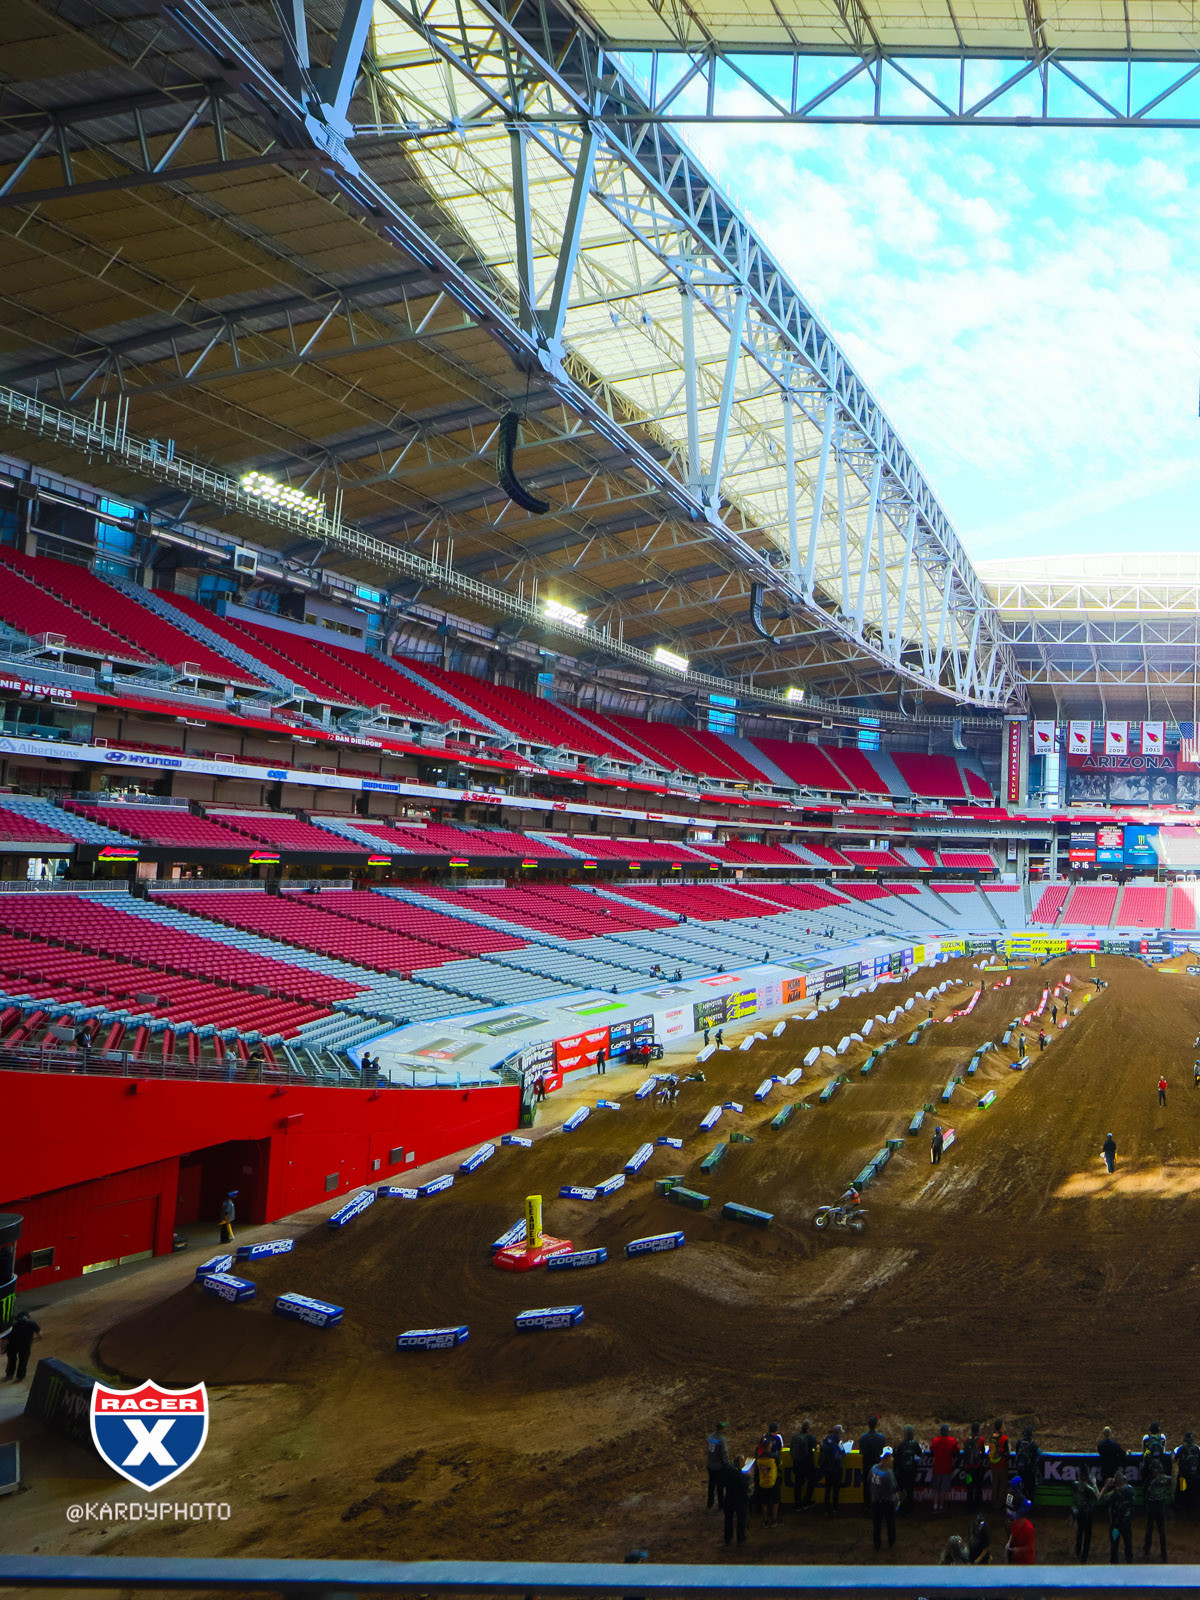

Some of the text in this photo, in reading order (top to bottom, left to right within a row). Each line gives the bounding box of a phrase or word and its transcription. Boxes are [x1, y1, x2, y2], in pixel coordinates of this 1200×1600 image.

[25, 683, 73, 698] NEVERS
[335, 735, 350, 743] DAN
[351, 737, 383, 748] DIERDORF
[17, 742, 79, 759] Albertsons
[129, 754, 182, 767] HYUNDAI
[1082, 755, 1175, 769] ARIZONA
[201, 763, 248, 775] HYUNDAI
[267, 769, 288, 780] COX
[324, 776, 342, 785] COX
[611, 1023, 631, 1033] GoPro
[634, 1018, 652, 1026] GoPro
[611, 1040, 631, 1050] GoPro
[389, 1186, 419, 1195] COOPER
[427, 1176, 454, 1193] COOPER
[570, 1188, 598, 1196] COOPER
[341, 1193, 375, 1224] COOPER
[251, 1239, 293, 1254] COOPER
[272, 1246, 292, 1255] TIRES
[628, 1238, 675, 1252] COOPER
[651, 1244, 675, 1252] TIRES
[542, 1247, 572, 1260] HONDA
[549, 1253, 598, 1266] COOPER
[203, 1278, 238, 1296] COOPER
[219, 1288, 236, 1302] TIRES
[276, 1300, 328, 1321] COOPER
[300, 1313, 326, 1327] TIRES
[516, 1314, 571, 1327] COOPER
[543, 1322, 571, 1330] TIRES
[398, 1333, 455, 1346] COOPER
[426, 1341, 454, 1350] TIRES
